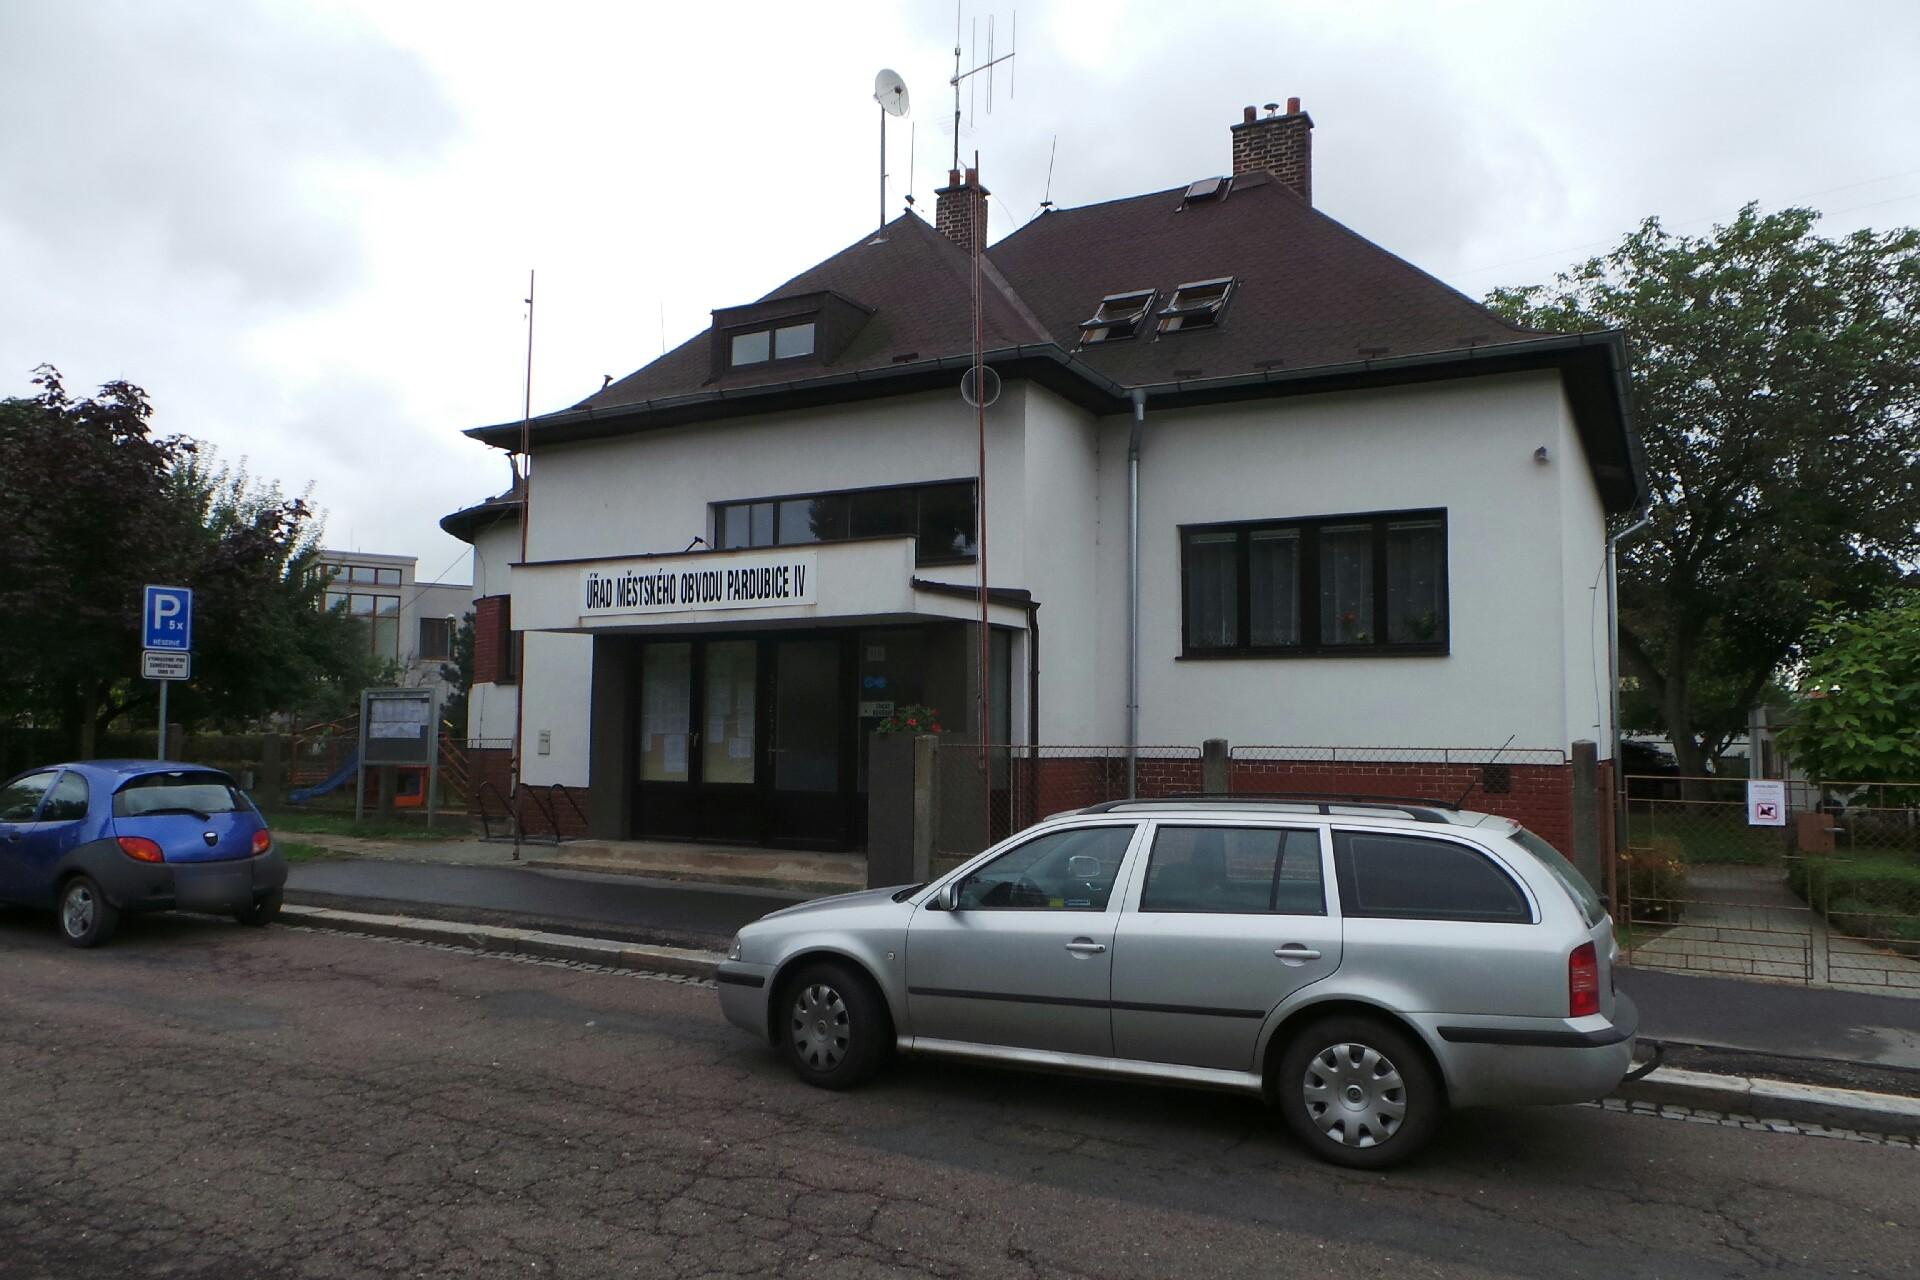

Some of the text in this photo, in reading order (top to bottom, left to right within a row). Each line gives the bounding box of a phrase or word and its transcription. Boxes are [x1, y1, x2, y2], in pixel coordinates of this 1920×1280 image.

[586, 564, 806, 609] ÚŘAD MĚSTSKÉHO OBVODU PARDUBICE IV
[154, 594, 180, 630] P
